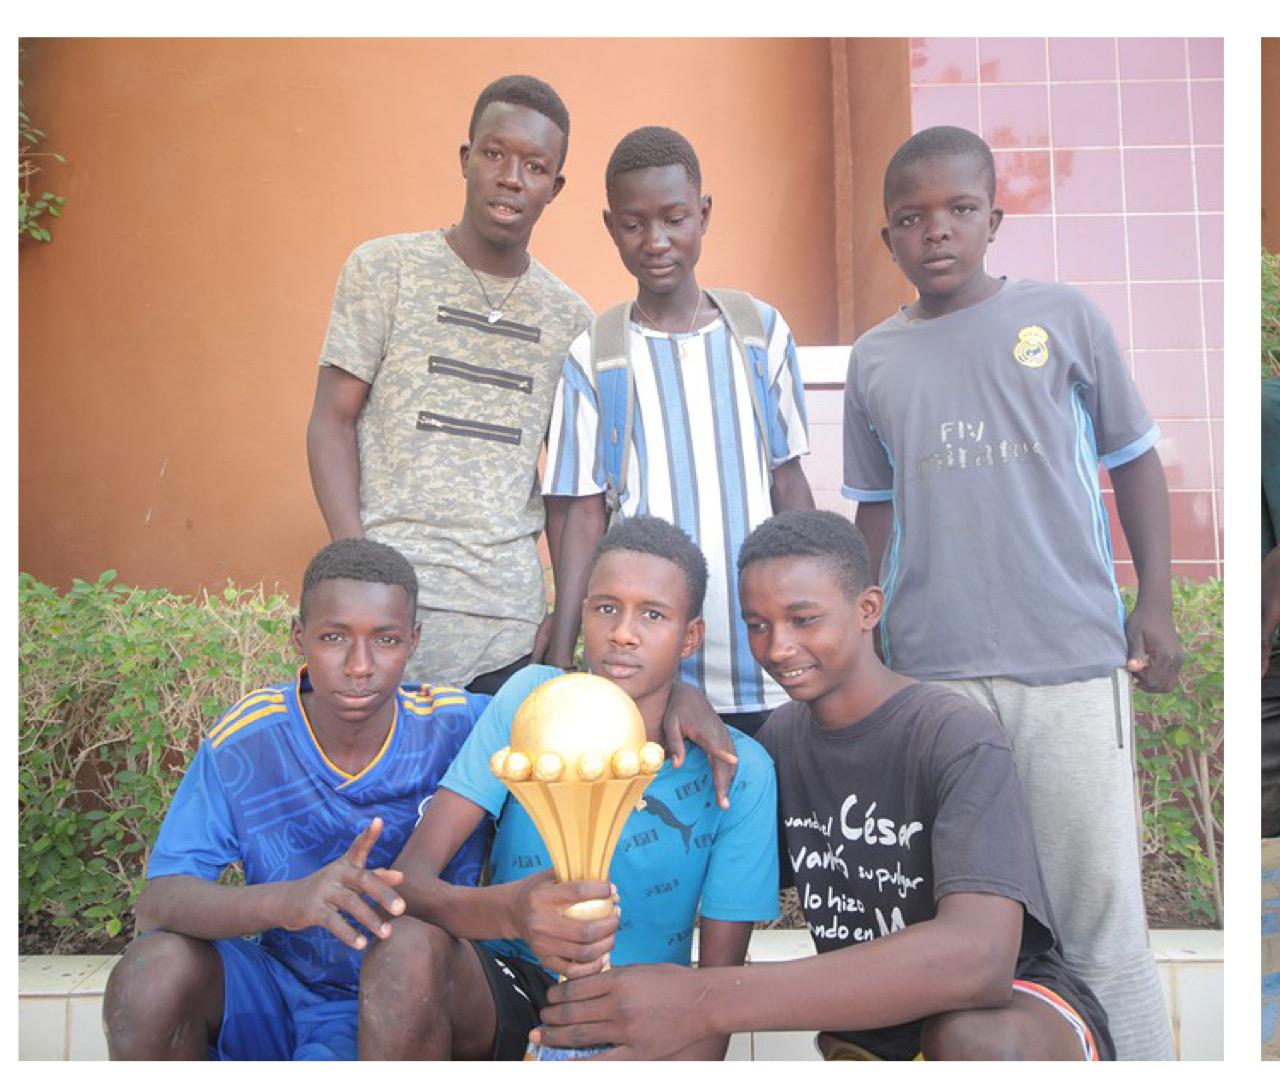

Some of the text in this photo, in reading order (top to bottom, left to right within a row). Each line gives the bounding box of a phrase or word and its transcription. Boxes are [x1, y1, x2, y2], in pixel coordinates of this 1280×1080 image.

[840, 794, 924, 850] César
[803, 882, 865, 914] lo hizo
[811, 915, 849, 939] ndo
[853, 926, 874, 941] en
